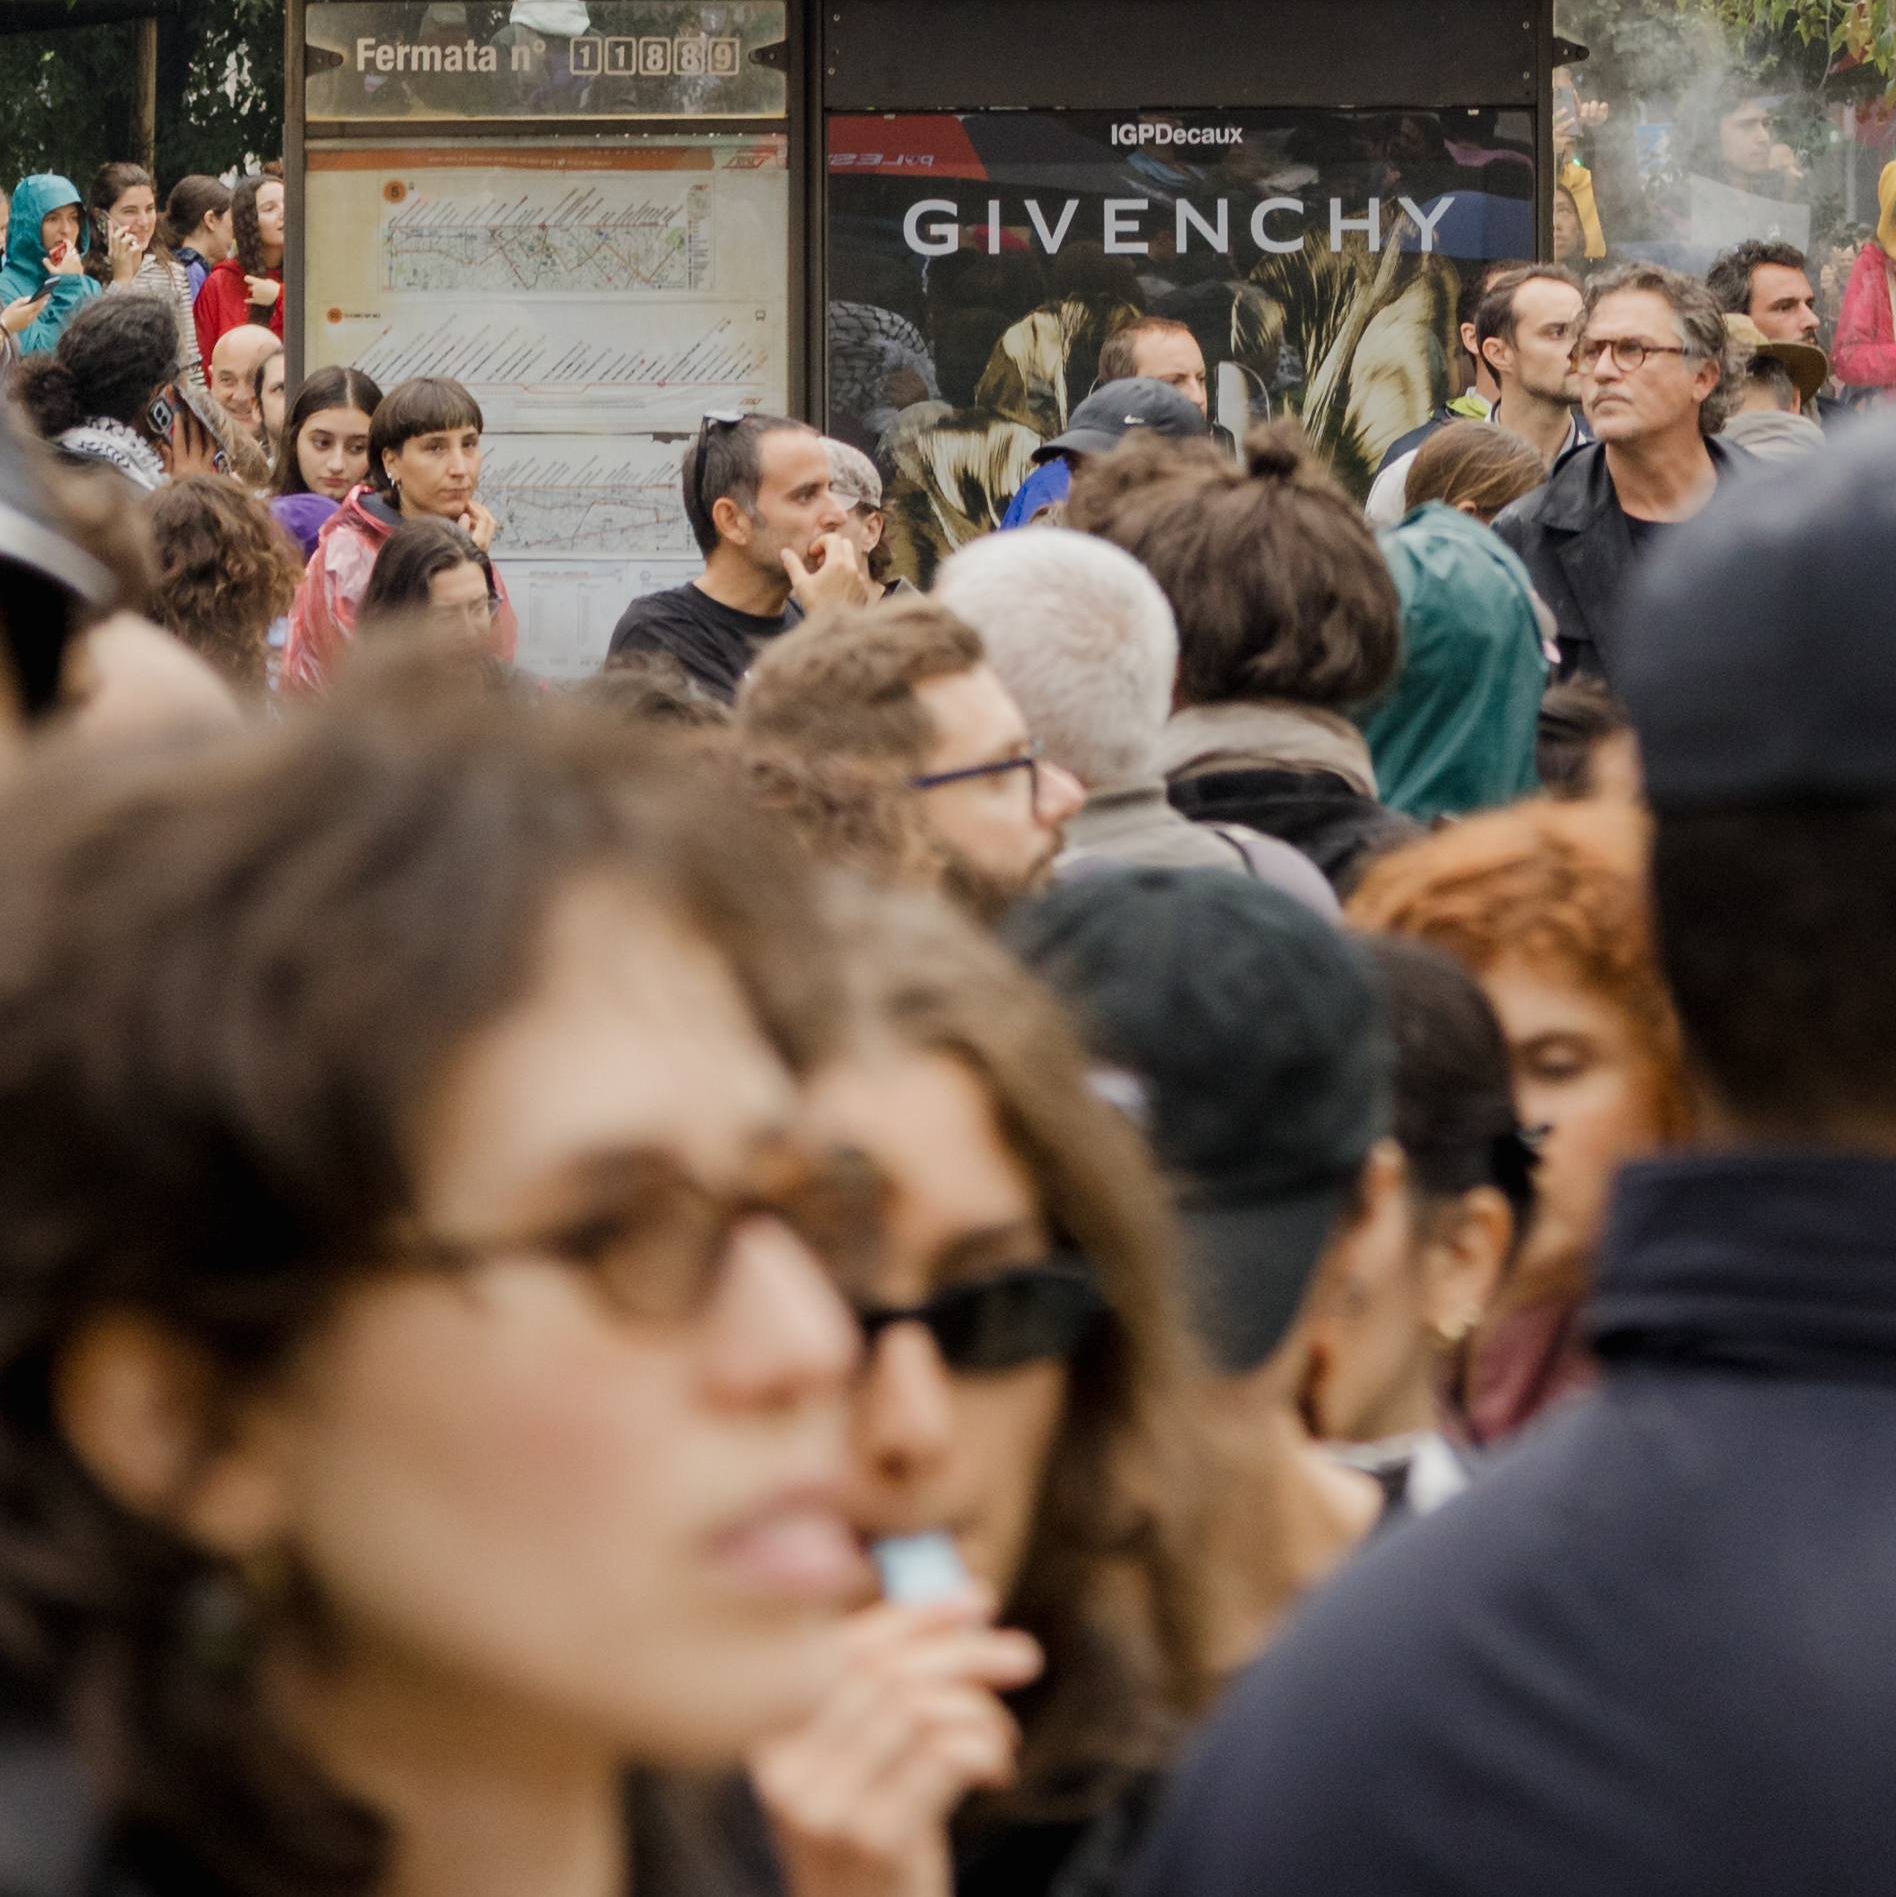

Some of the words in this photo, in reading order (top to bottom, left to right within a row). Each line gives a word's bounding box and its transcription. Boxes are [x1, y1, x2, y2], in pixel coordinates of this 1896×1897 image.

[356, 38, 497, 72] Fermata
[511, 39, 547, 71] n°
[1111, 124, 1243, 145] IGPDecaux
[902, 197, 1457, 256] GIVENCHY
